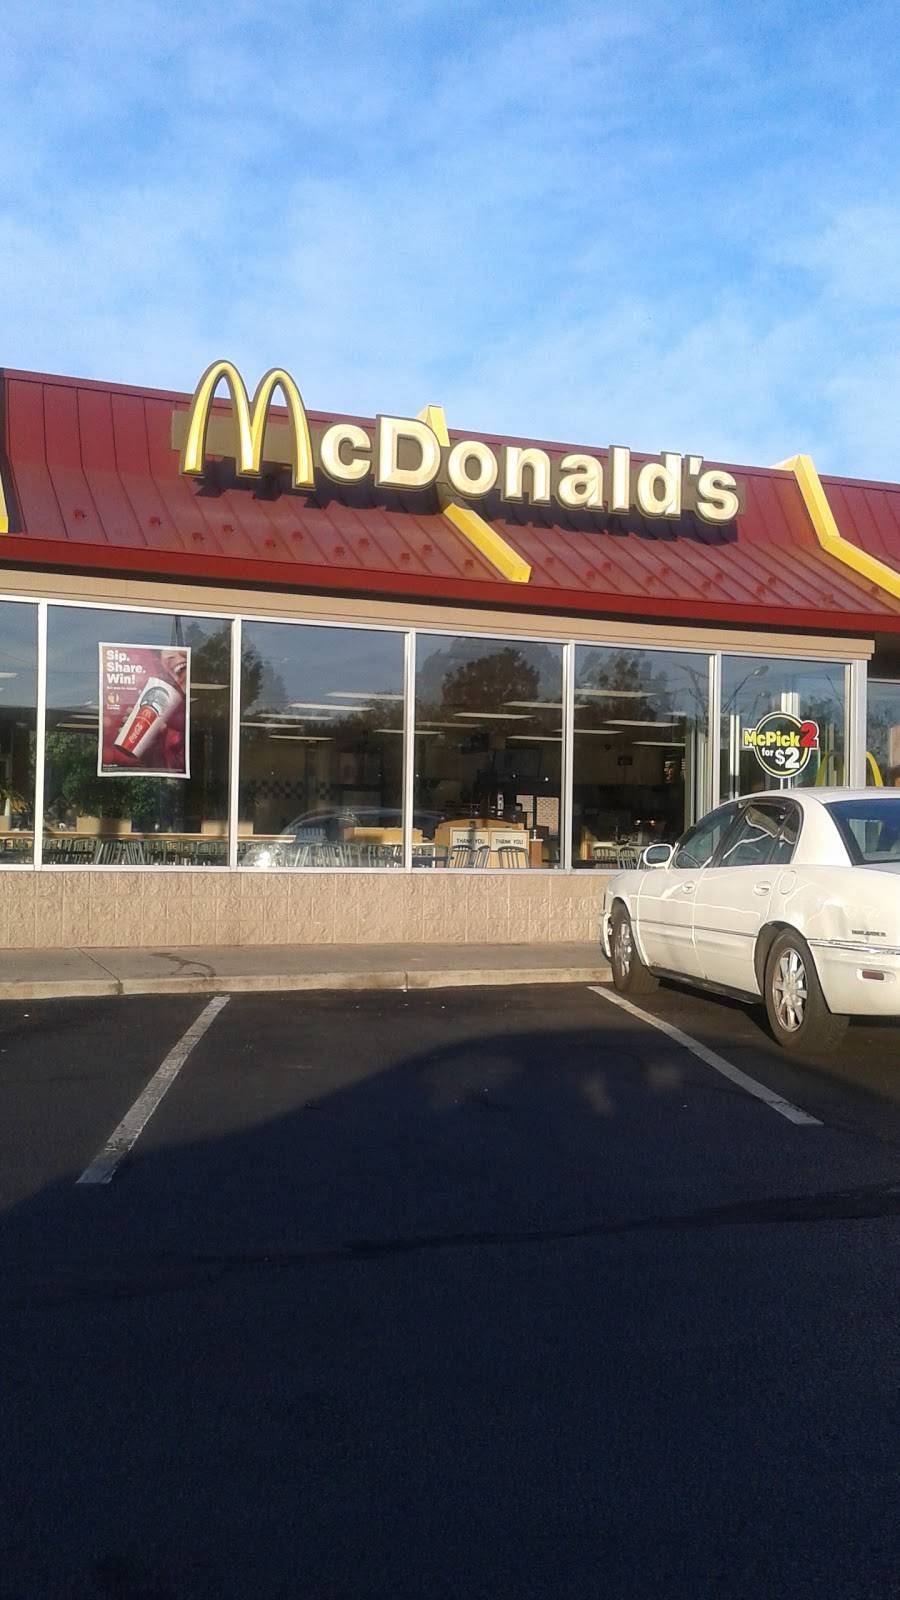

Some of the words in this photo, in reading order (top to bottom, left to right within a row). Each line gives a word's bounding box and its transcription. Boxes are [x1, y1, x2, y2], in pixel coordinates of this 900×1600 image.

[180, 360, 740, 523] McDonald's
[106, 650, 130, 663] Sip.
[106, 662, 146, 673] Share.
[106, 673, 136, 684] Win!
[744, 730, 800, 747] McPick
[761, 747, 774, 756] for
[775, 747, 800, 768] $2
